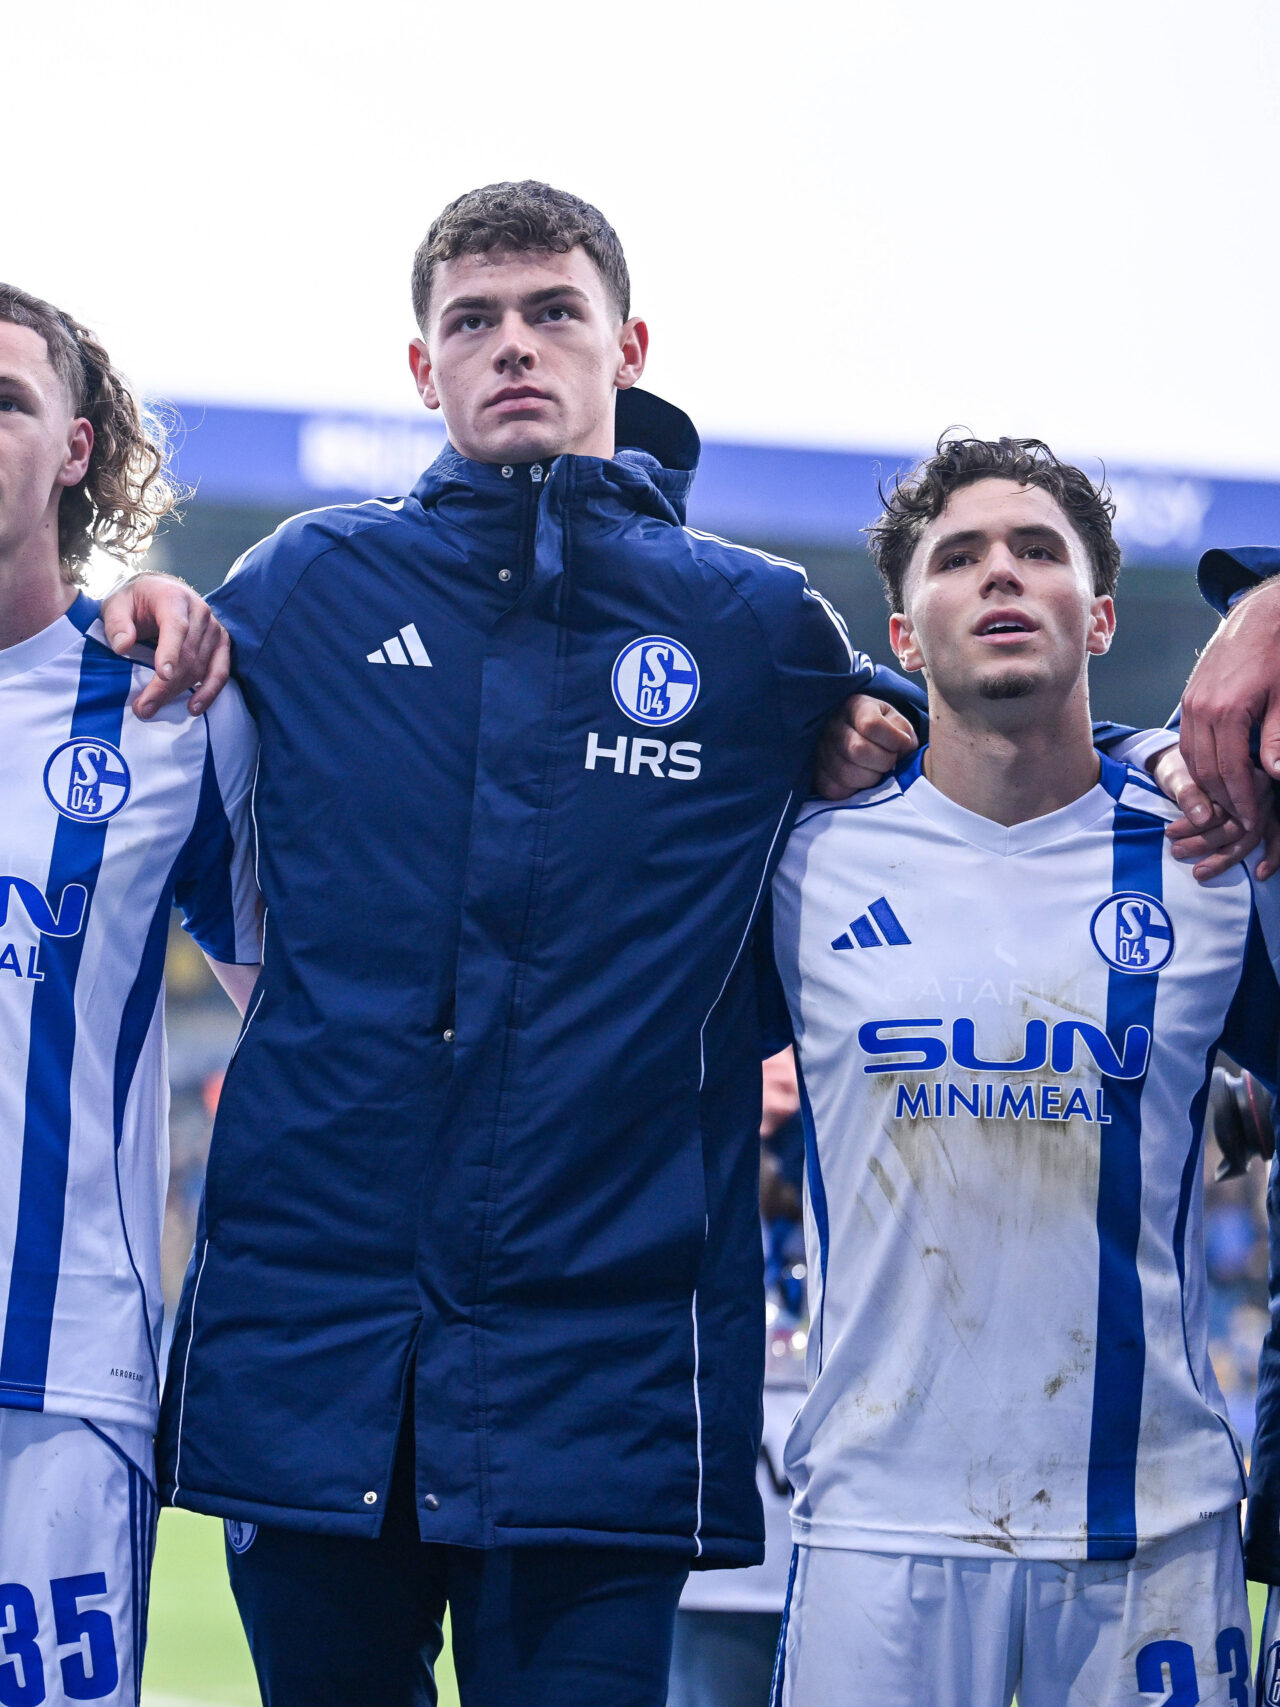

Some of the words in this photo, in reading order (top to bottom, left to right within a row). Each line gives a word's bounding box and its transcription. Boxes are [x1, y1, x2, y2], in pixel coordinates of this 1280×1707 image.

[639, 687, 665, 715] 04
[584, 731, 703, 781] HRS
[70, 785, 97, 813] 04
[1118, 939, 1145, 965] 04
[857, 1016, 1151, 1080] SUN
[894, 1081, 1112, 1125] MINIMEAL
